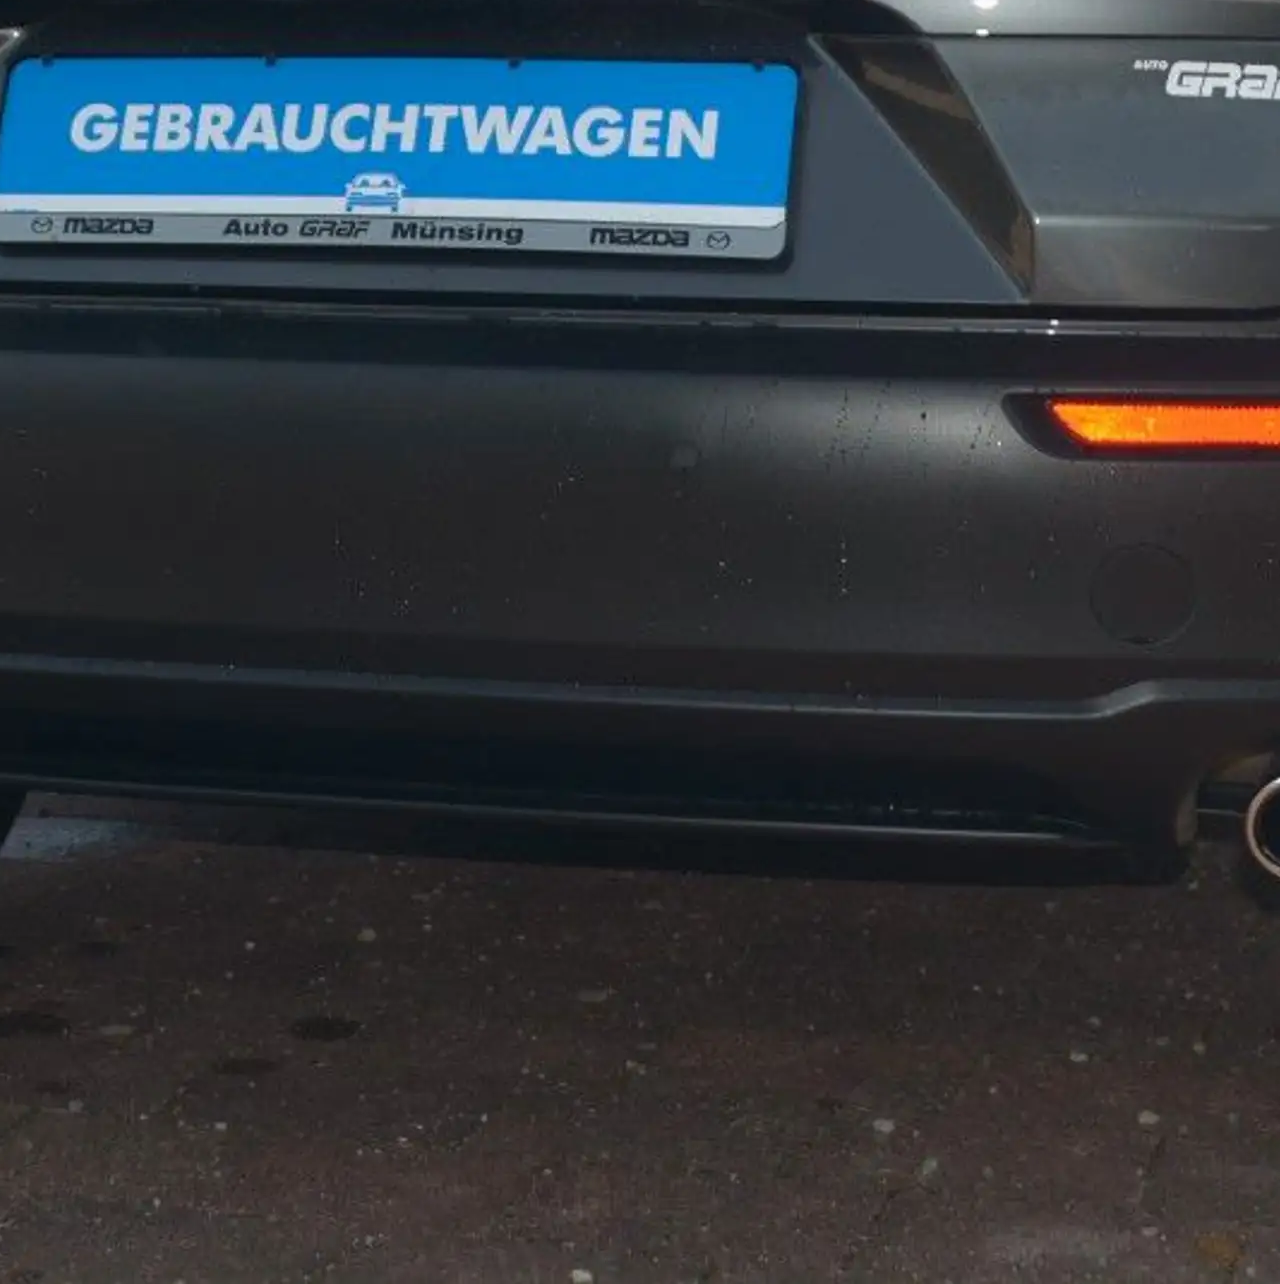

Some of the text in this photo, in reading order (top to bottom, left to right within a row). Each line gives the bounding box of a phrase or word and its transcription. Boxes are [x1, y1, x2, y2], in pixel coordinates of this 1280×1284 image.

[70, 102, 719, 160] GEBRAUCHTWAGEN
[222, 218, 289, 238] Auto
[390, 222, 524, 246] Münsing
